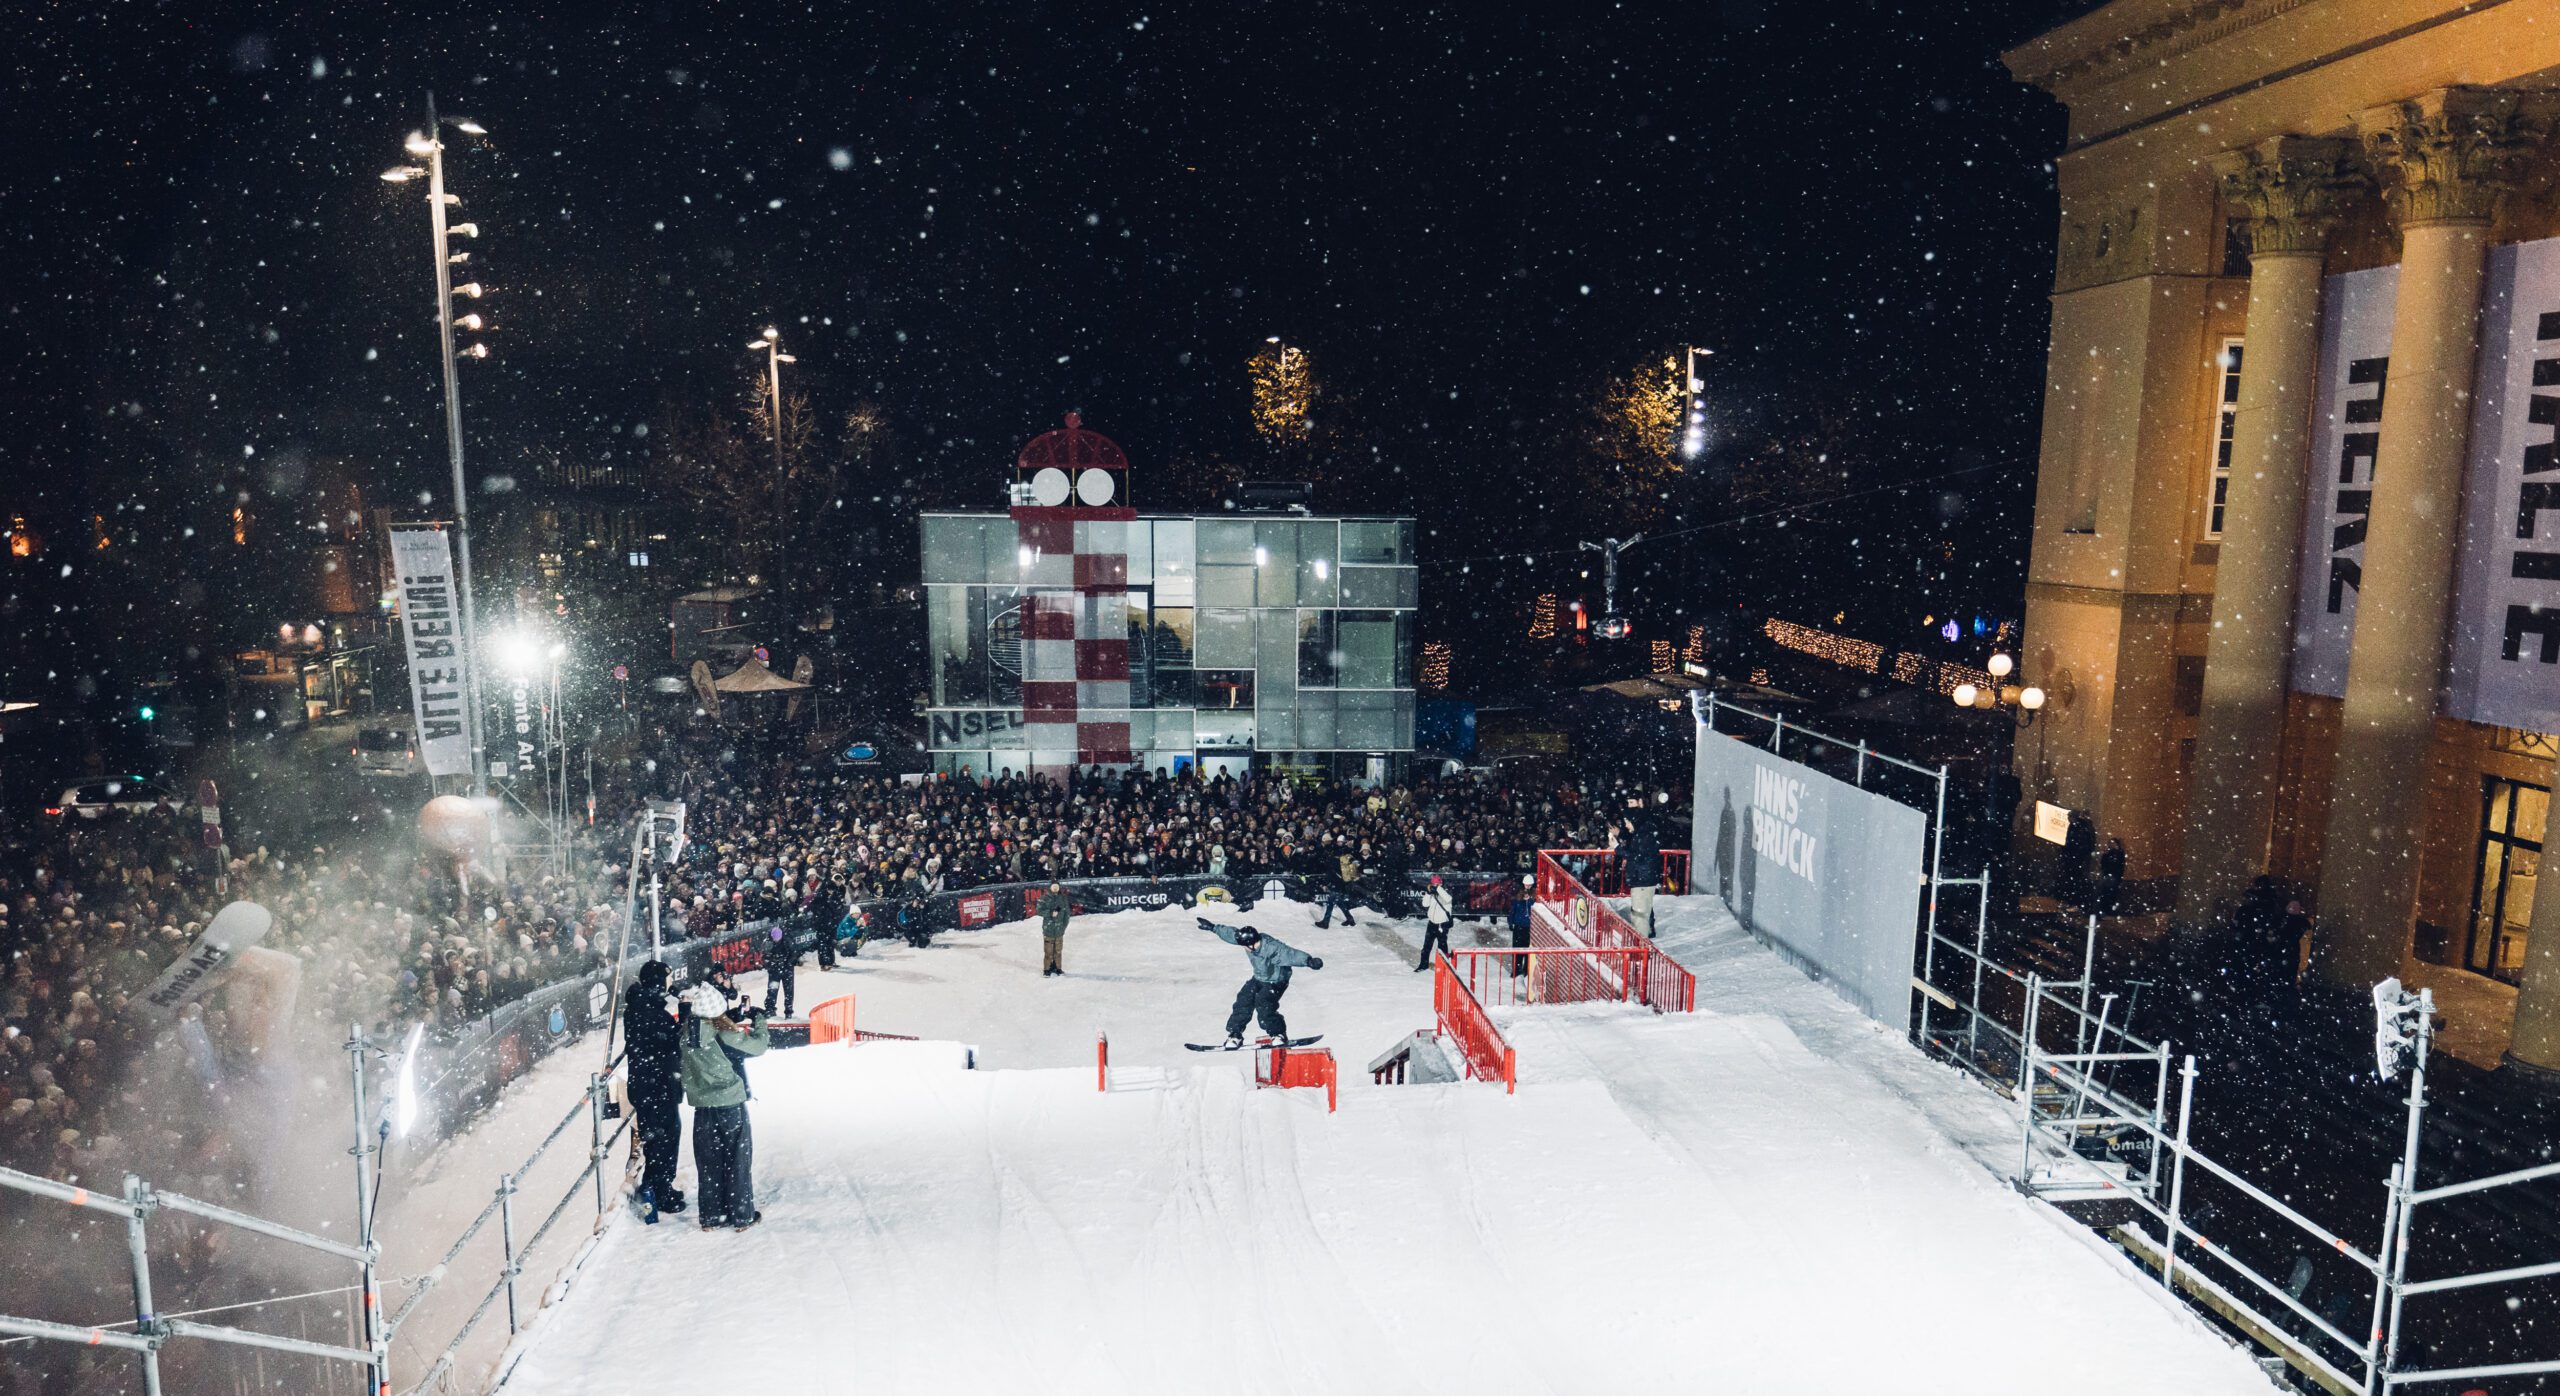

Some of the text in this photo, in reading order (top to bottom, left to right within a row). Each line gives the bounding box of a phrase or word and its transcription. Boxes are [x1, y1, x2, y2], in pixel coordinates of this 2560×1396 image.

[517, 740, 536, 771] Art
[1751, 807, 1817, 883] BRUCK
[1107, 892, 1168, 906] NIDECKER
[724, 950, 765, 975] RUCK
